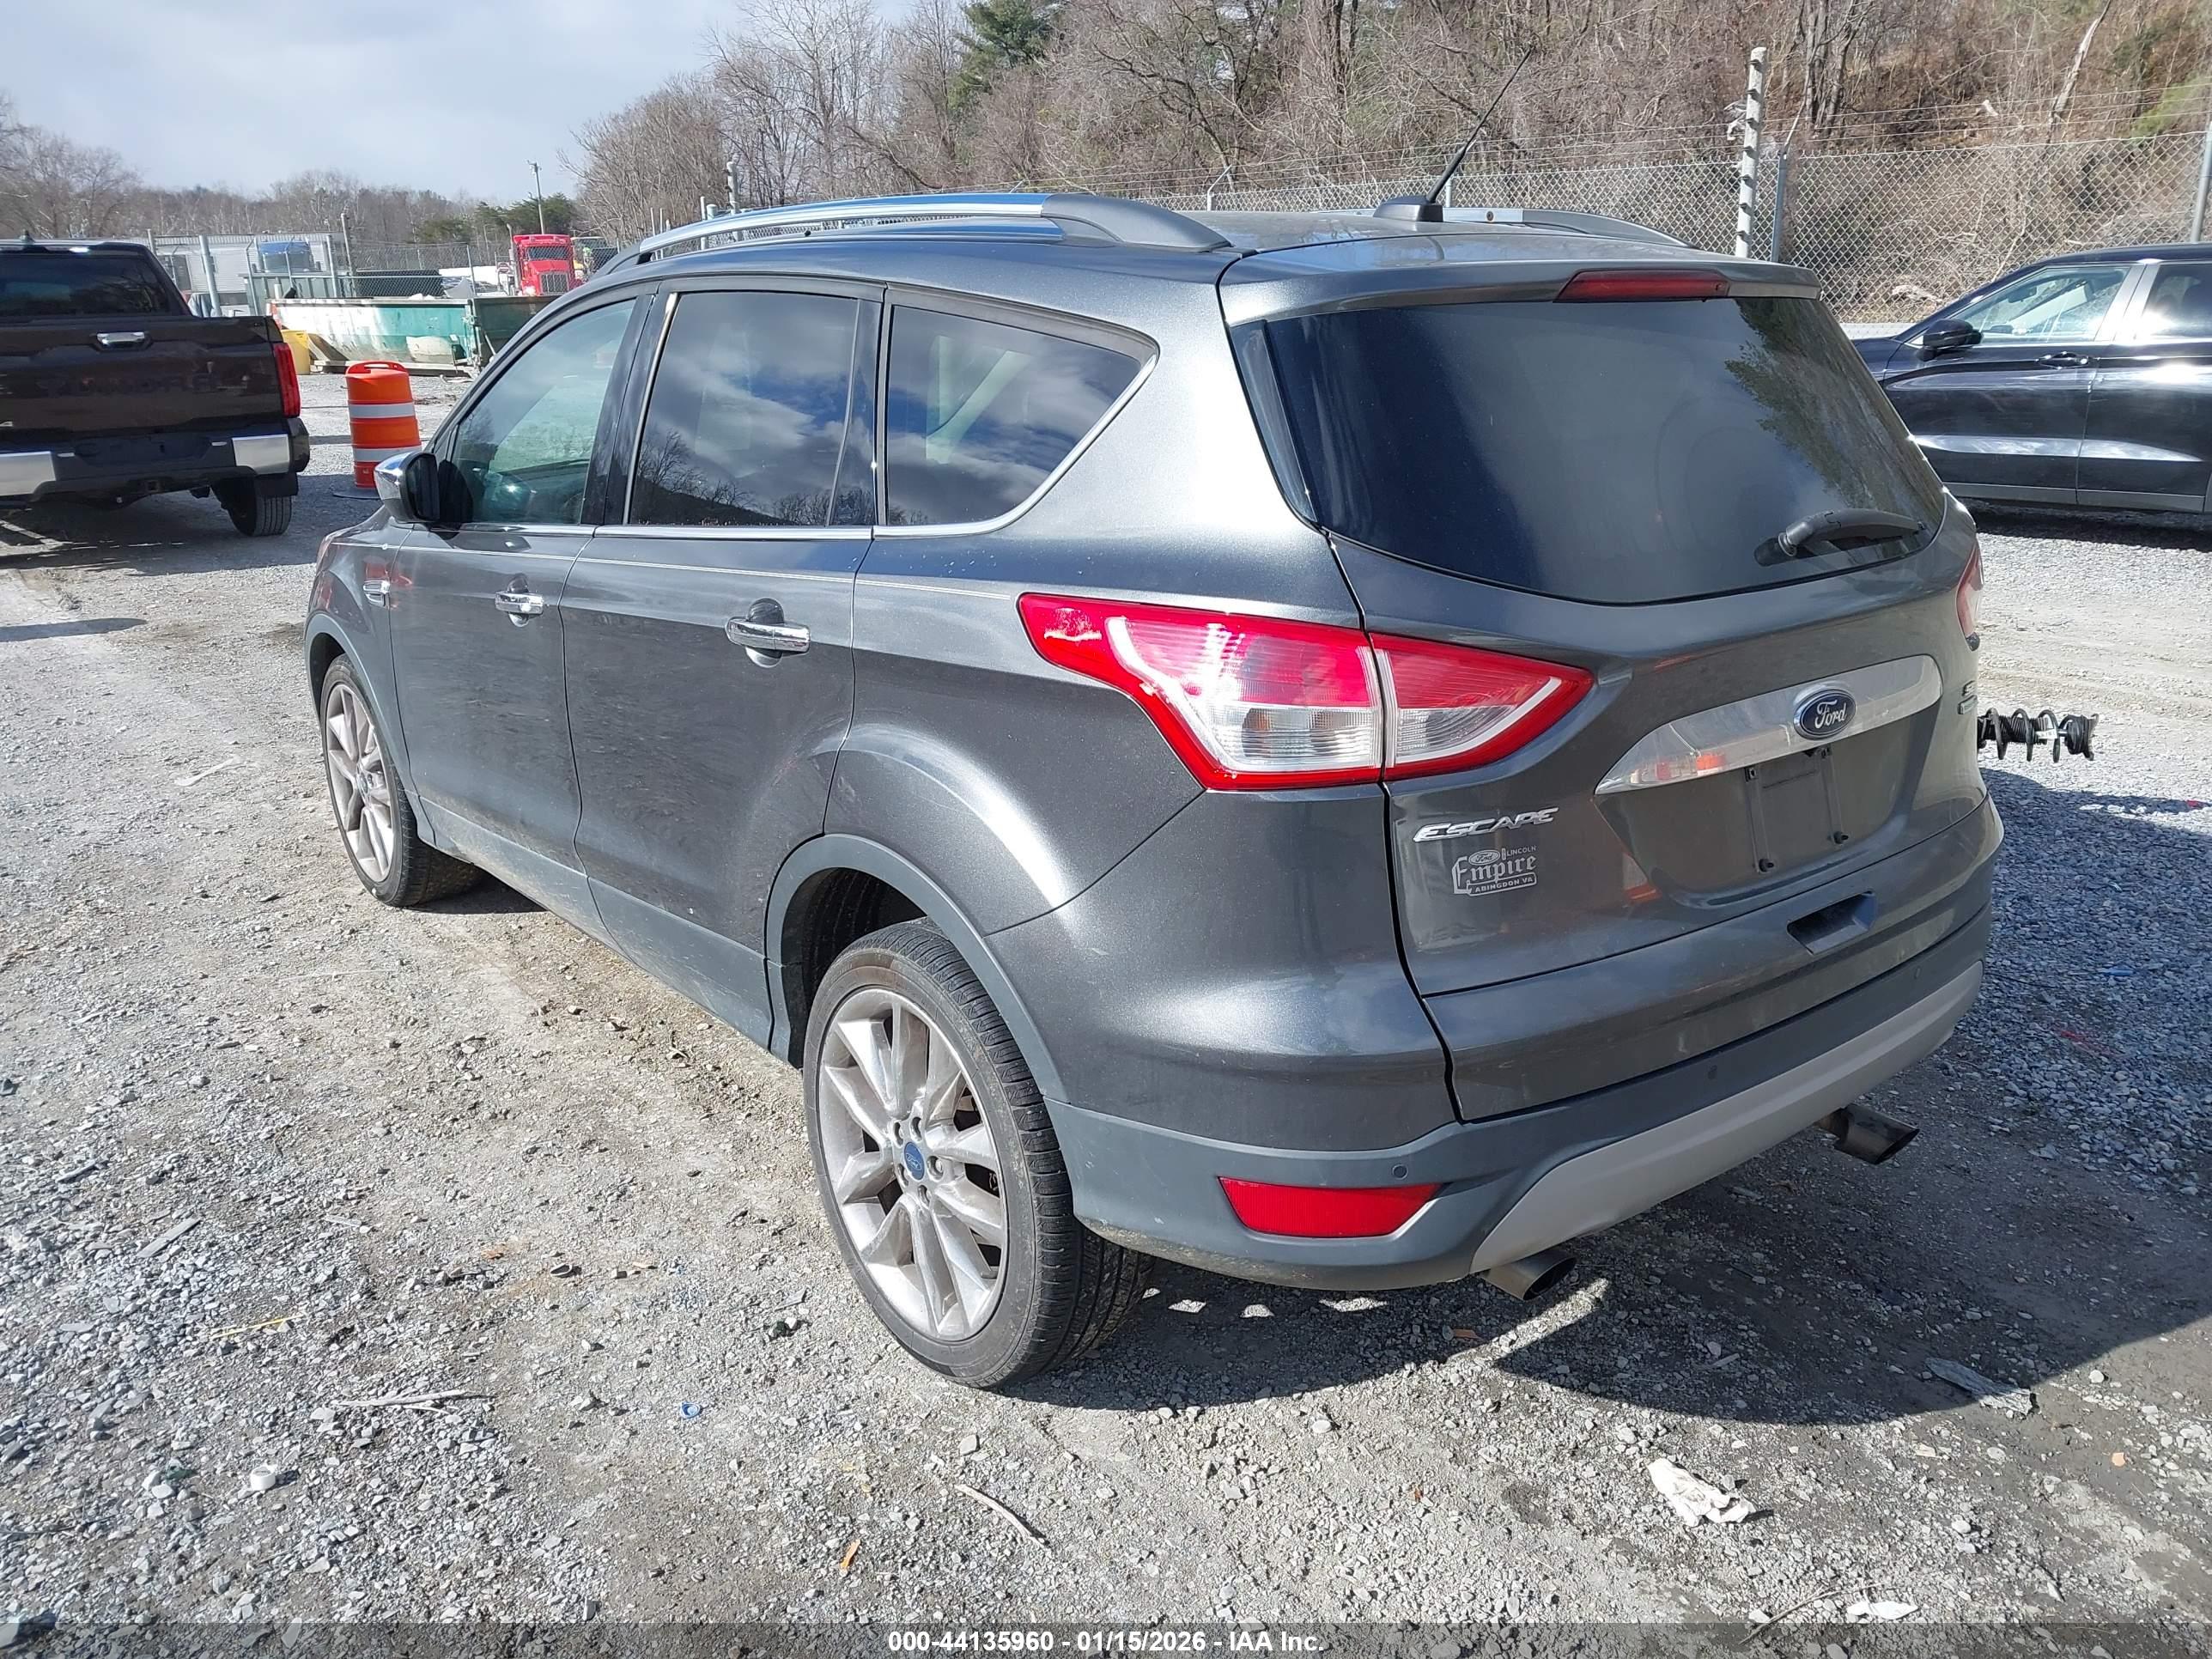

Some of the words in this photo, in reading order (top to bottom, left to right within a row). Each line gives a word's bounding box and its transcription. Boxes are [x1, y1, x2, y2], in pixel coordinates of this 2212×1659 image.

[1814, 699, 1846, 729] Ford
[1413, 807, 1559, 842] ESCAPE
[1506, 845, 1536, 857] LINCOLN
[1451, 855, 1537, 894] Empire
